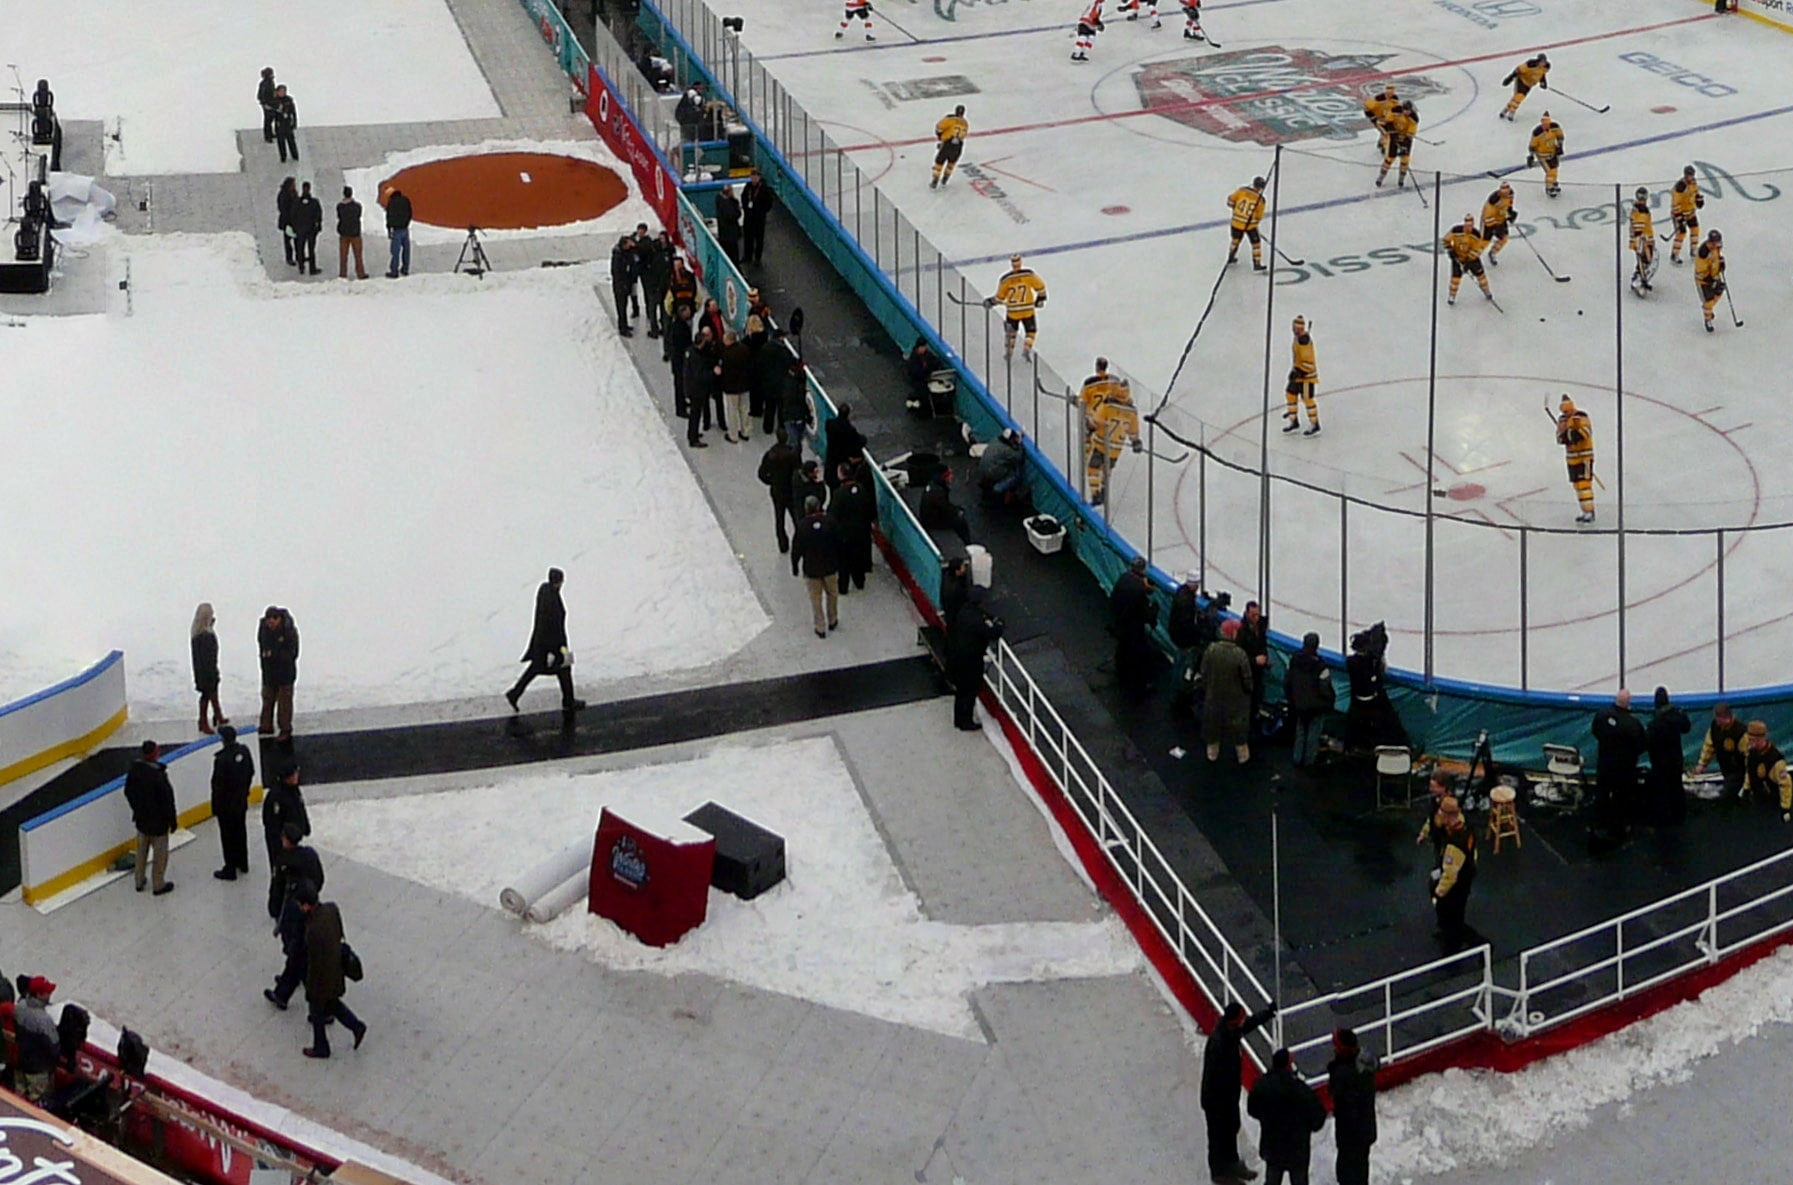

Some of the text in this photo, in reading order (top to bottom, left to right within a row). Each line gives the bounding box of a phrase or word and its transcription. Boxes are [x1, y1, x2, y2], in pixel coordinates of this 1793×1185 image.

[1440, 0, 1497, 30] HONDA
[1618, 49, 1739, 99] GEICO
[1006, 284, 1027, 305] 27
